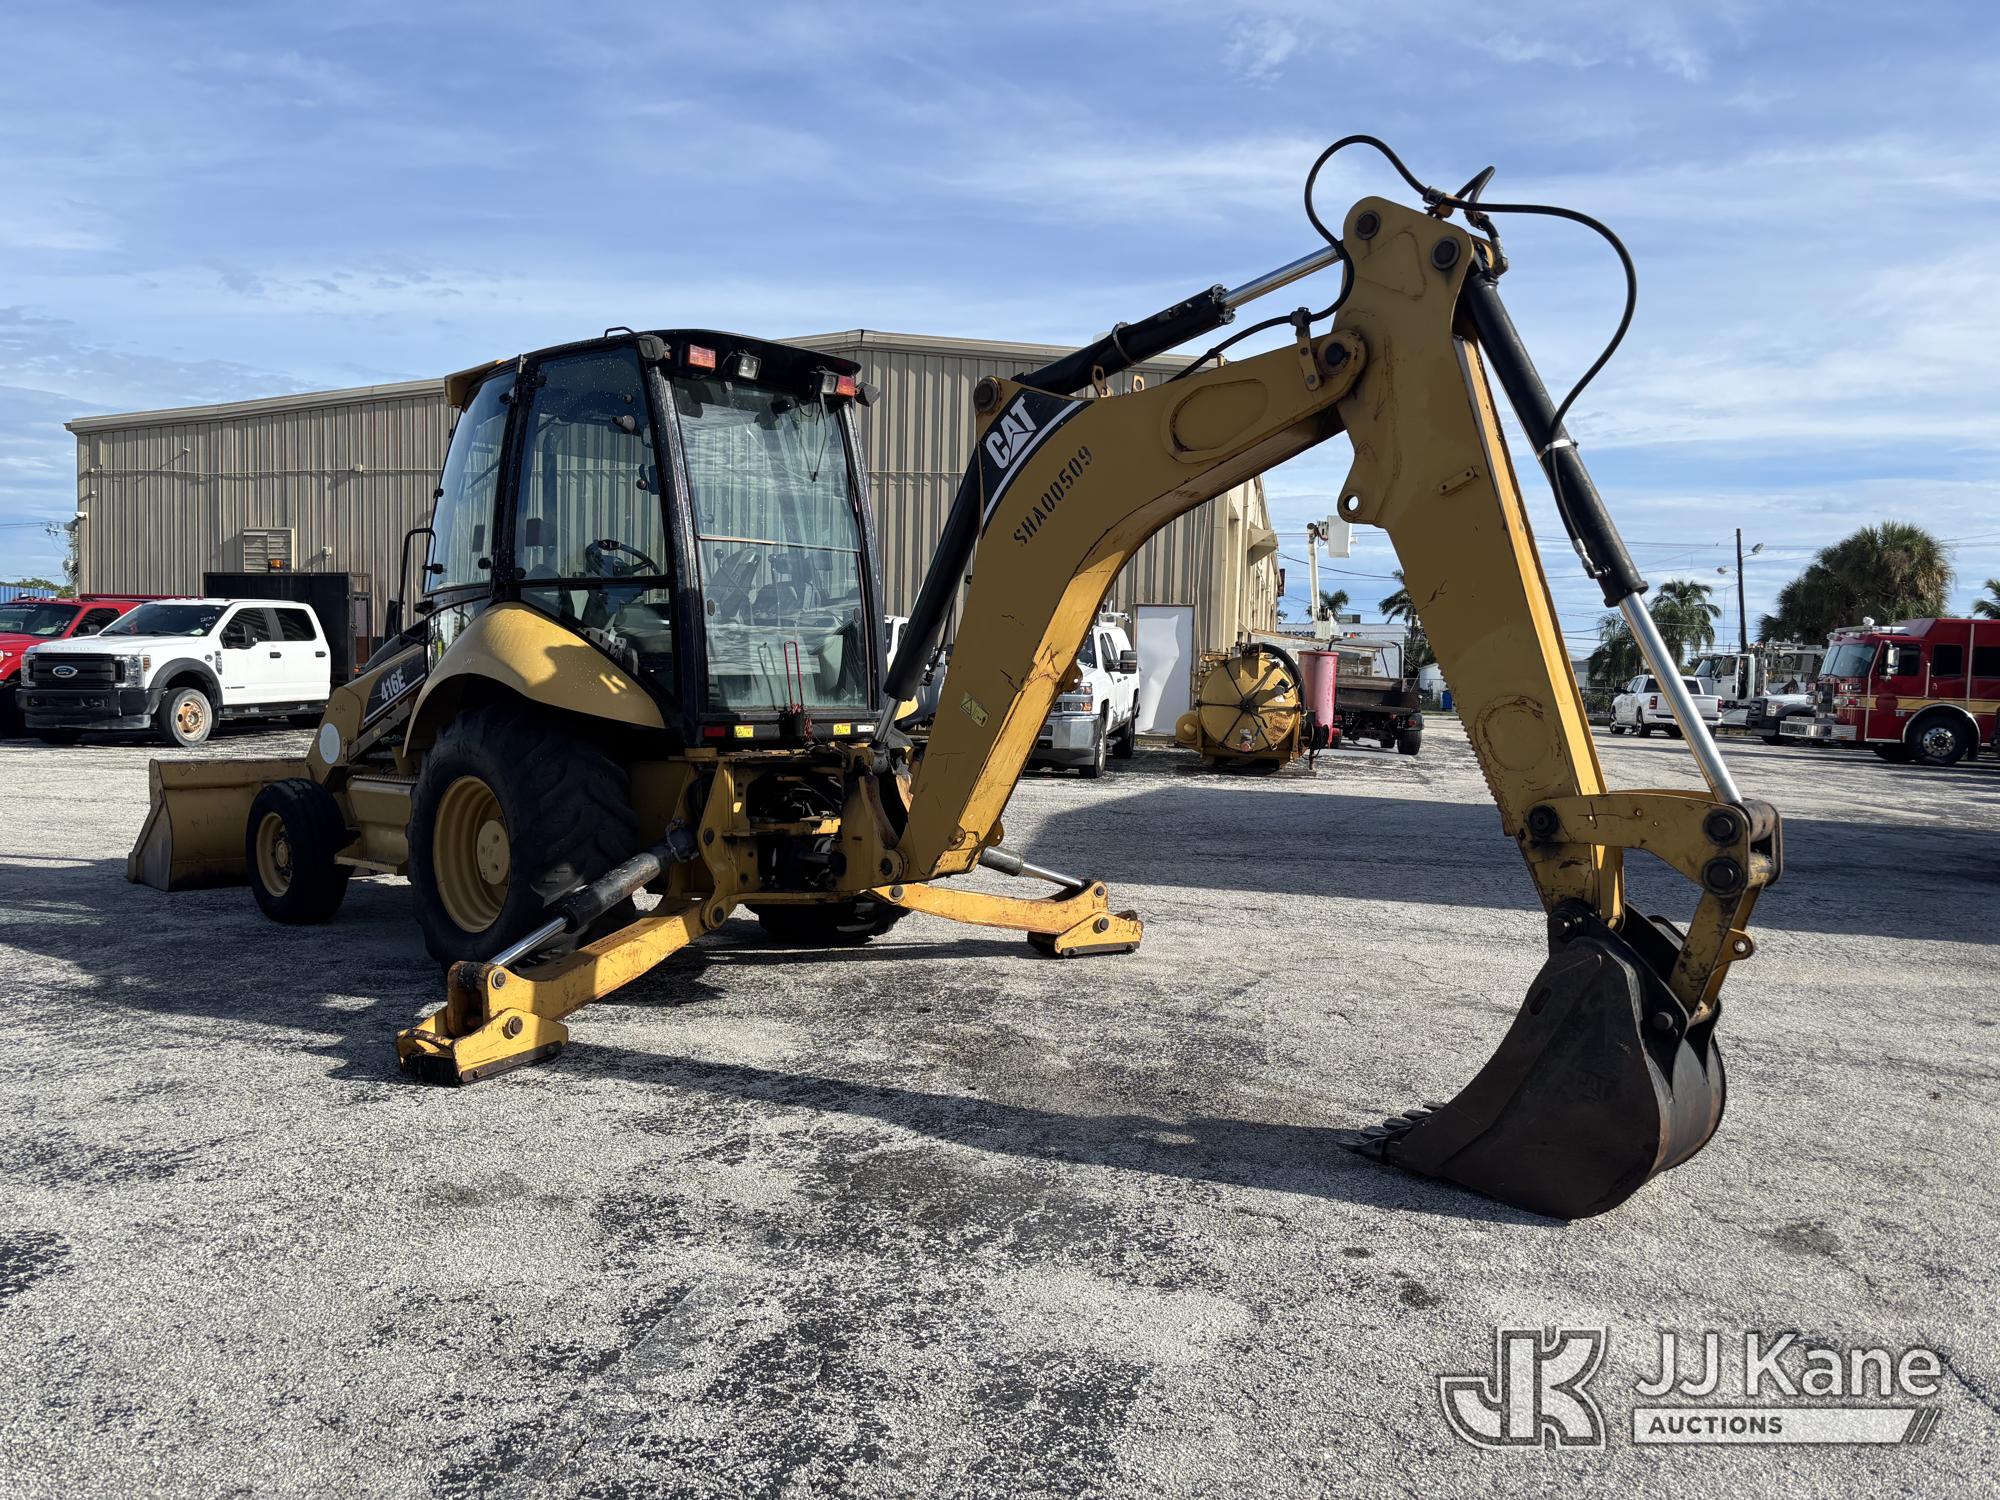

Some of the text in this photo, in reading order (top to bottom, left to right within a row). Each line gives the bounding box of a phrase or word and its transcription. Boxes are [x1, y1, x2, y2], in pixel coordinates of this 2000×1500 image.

[986, 394, 1037, 469] CAT
[1013, 446, 1092, 545] SHA00509
[380, 667, 406, 701] 416E
